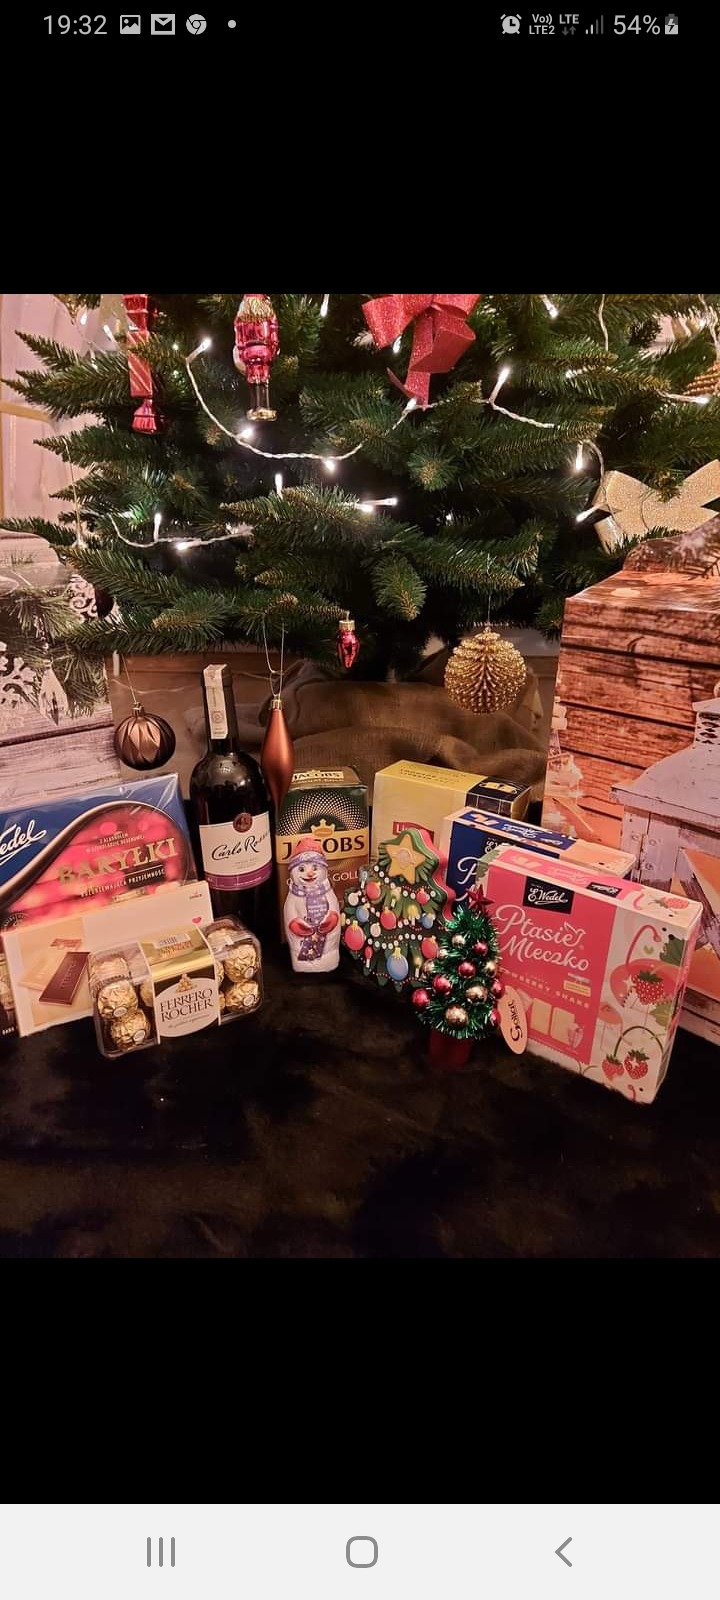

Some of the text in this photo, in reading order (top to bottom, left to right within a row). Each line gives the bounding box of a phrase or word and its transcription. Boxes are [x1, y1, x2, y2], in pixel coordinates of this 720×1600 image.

[212, 841, 242, 861] Carlo
[282, 835, 365, 860] JOBS
[496, 904, 585, 947] Ptasie
[501, 935, 589, 971] Mleczko
[160, 988, 213, 1012] FERRERO
[161, 998, 214, 1022] ROCHER
